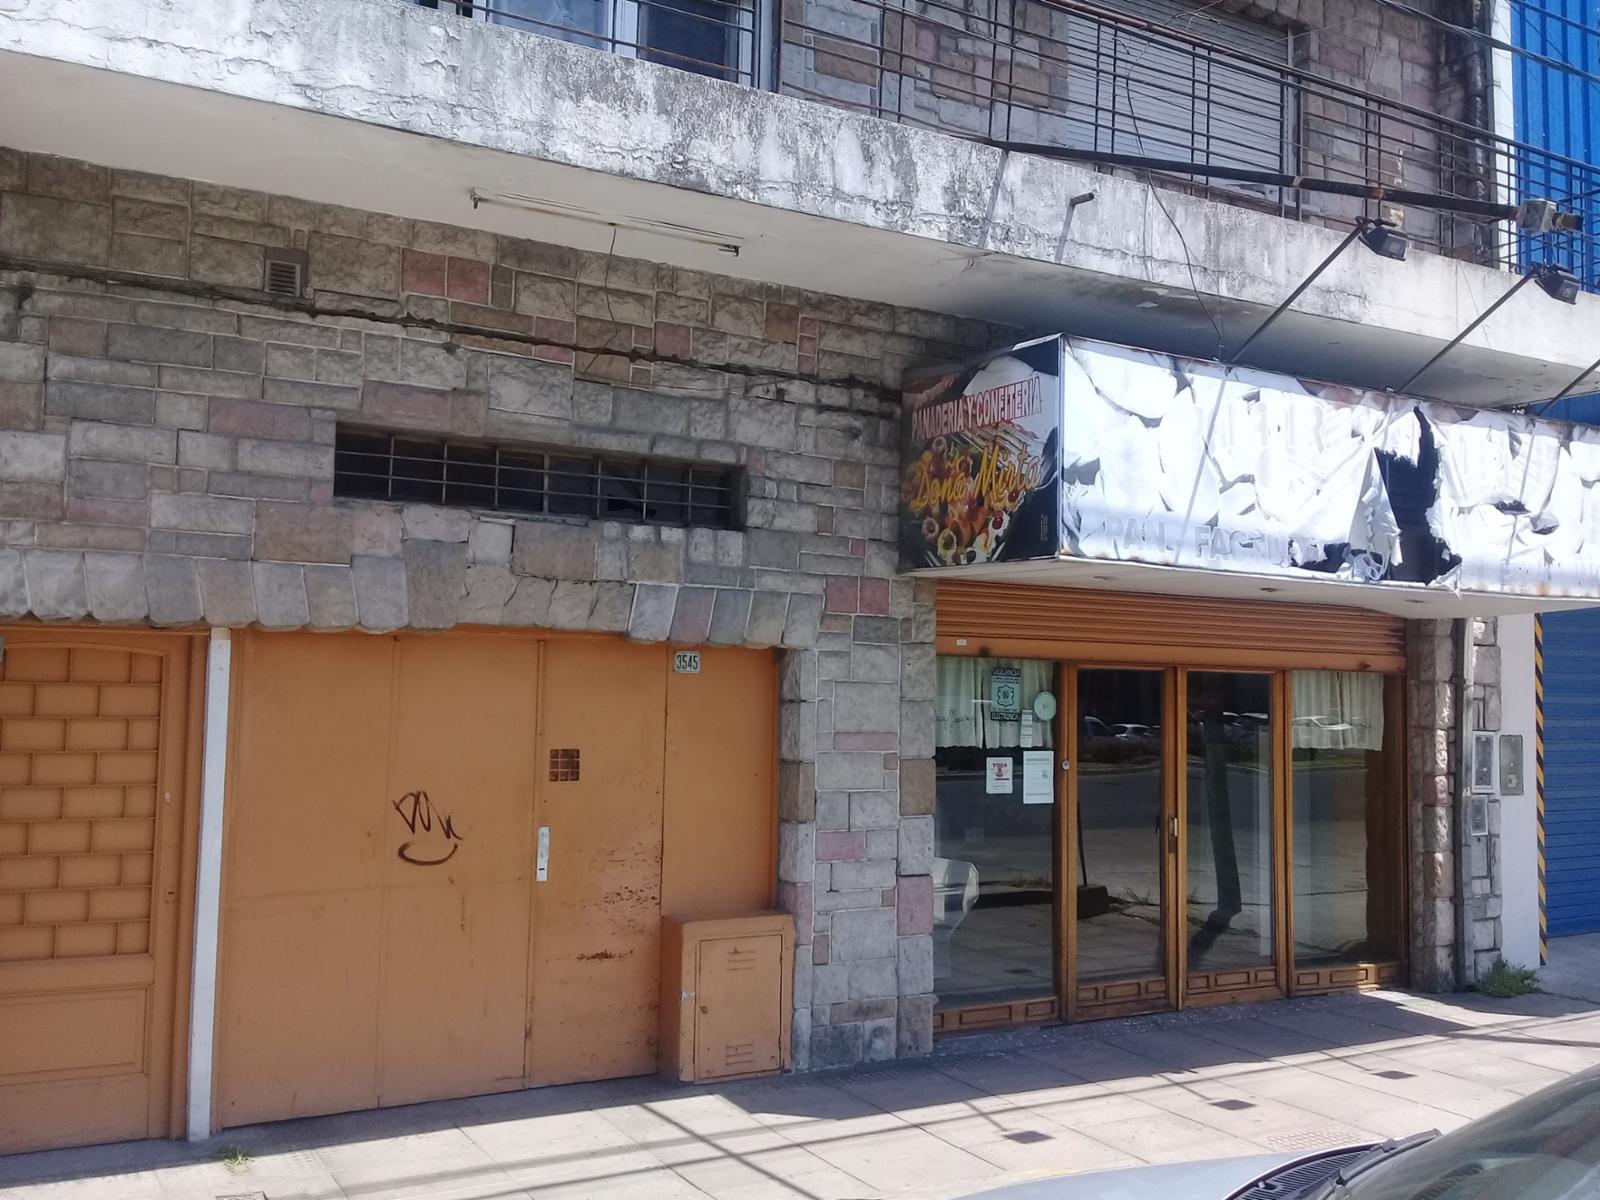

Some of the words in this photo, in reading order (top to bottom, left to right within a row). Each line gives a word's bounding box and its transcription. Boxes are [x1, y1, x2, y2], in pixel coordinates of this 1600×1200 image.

[911, 399, 965, 442] PANADERIA
[963, 395, 975, 429] Y
[976, 376, 1043, 428] CONFITERIA
[971, 443, 1041, 501] Mirta
[676, 654, 698, 670] 3545
